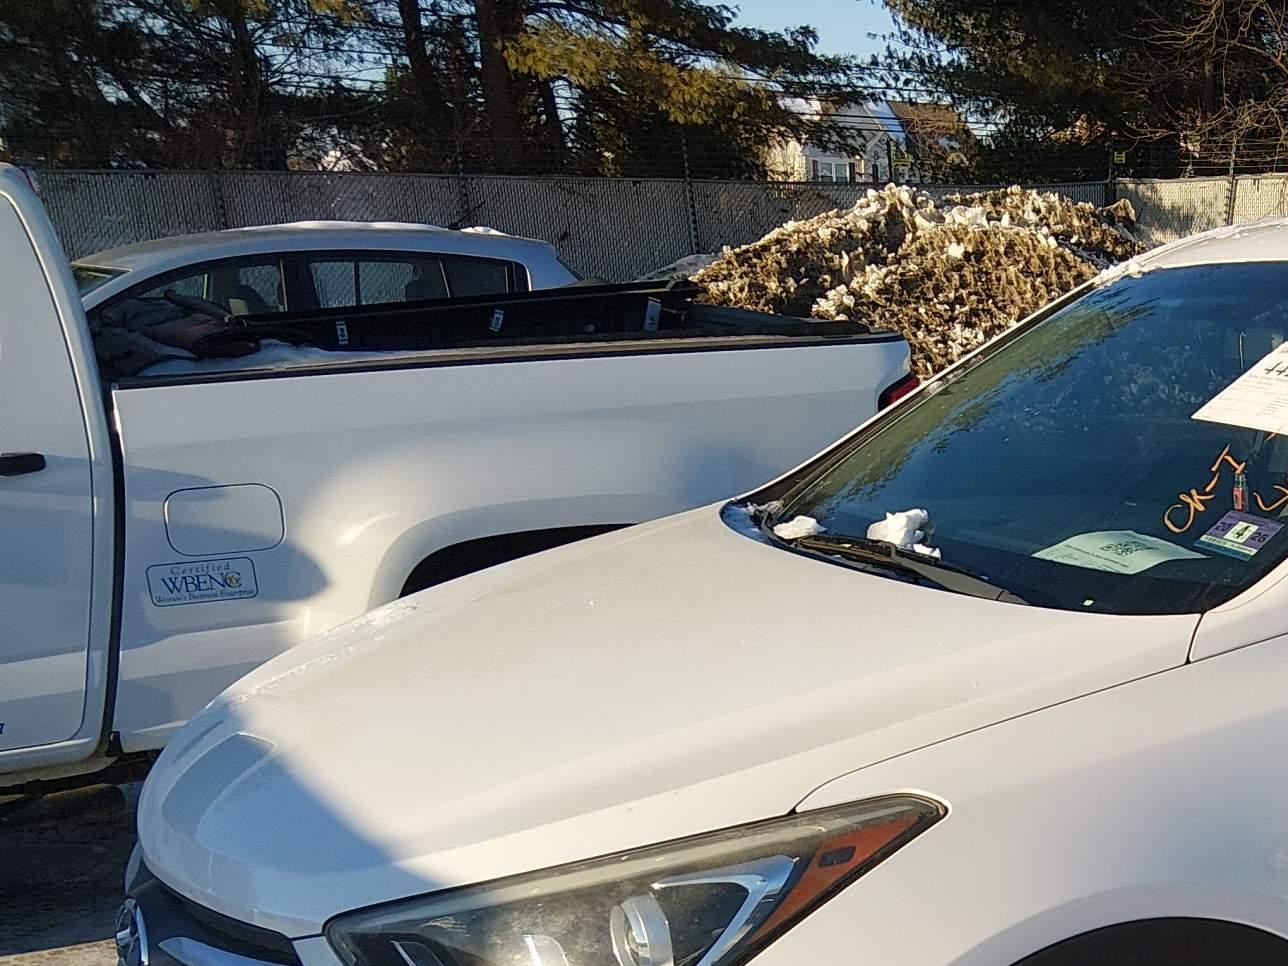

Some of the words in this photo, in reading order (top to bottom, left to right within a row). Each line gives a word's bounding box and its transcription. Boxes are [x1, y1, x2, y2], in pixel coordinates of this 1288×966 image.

[1236, 525, 1251, 540] 4
[1250, 532, 1269, 543] 26
[169, 560, 230, 576] Certified
